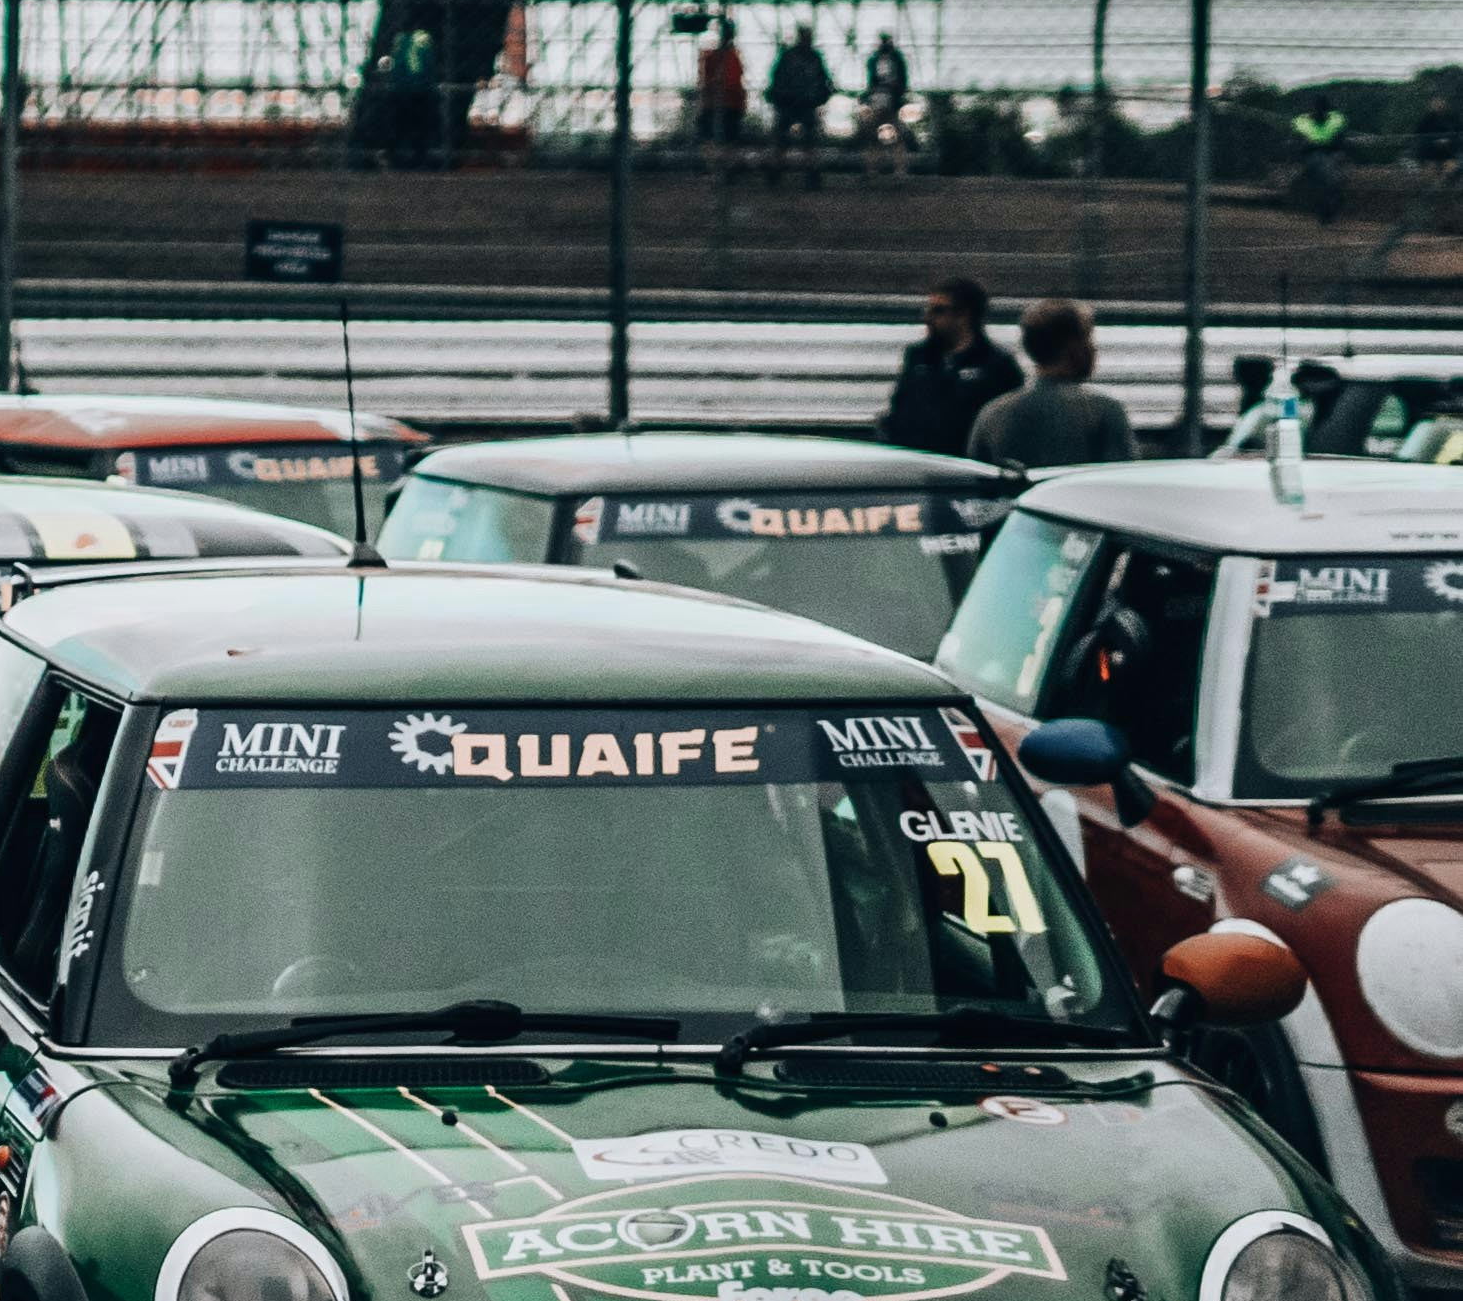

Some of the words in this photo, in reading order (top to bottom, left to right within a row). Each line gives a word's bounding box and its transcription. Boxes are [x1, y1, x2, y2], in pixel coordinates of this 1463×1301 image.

[751, 504, 923, 537] QUAIFE
[215, 754, 342, 775] CHALLENGE
[216, 724, 346, 759] MINI
[452, 725, 761, 782] QUAIFE
[817, 716, 936, 752] MINI
[839, 751, 945, 768] CHALLENGE
[900, 810, 1024, 842] GLENIE
[927, 841, 1048, 934] 27
[678, 1134, 860, 1162] CREDO
[502, 1207, 816, 1262] ACORN
[831, 1213, 1032, 1264] HIRE
[641, 1260, 755, 1285] PLANT
[767, 1258, 794, 1276] &
[800, 1258, 926, 1285] TOOLS
